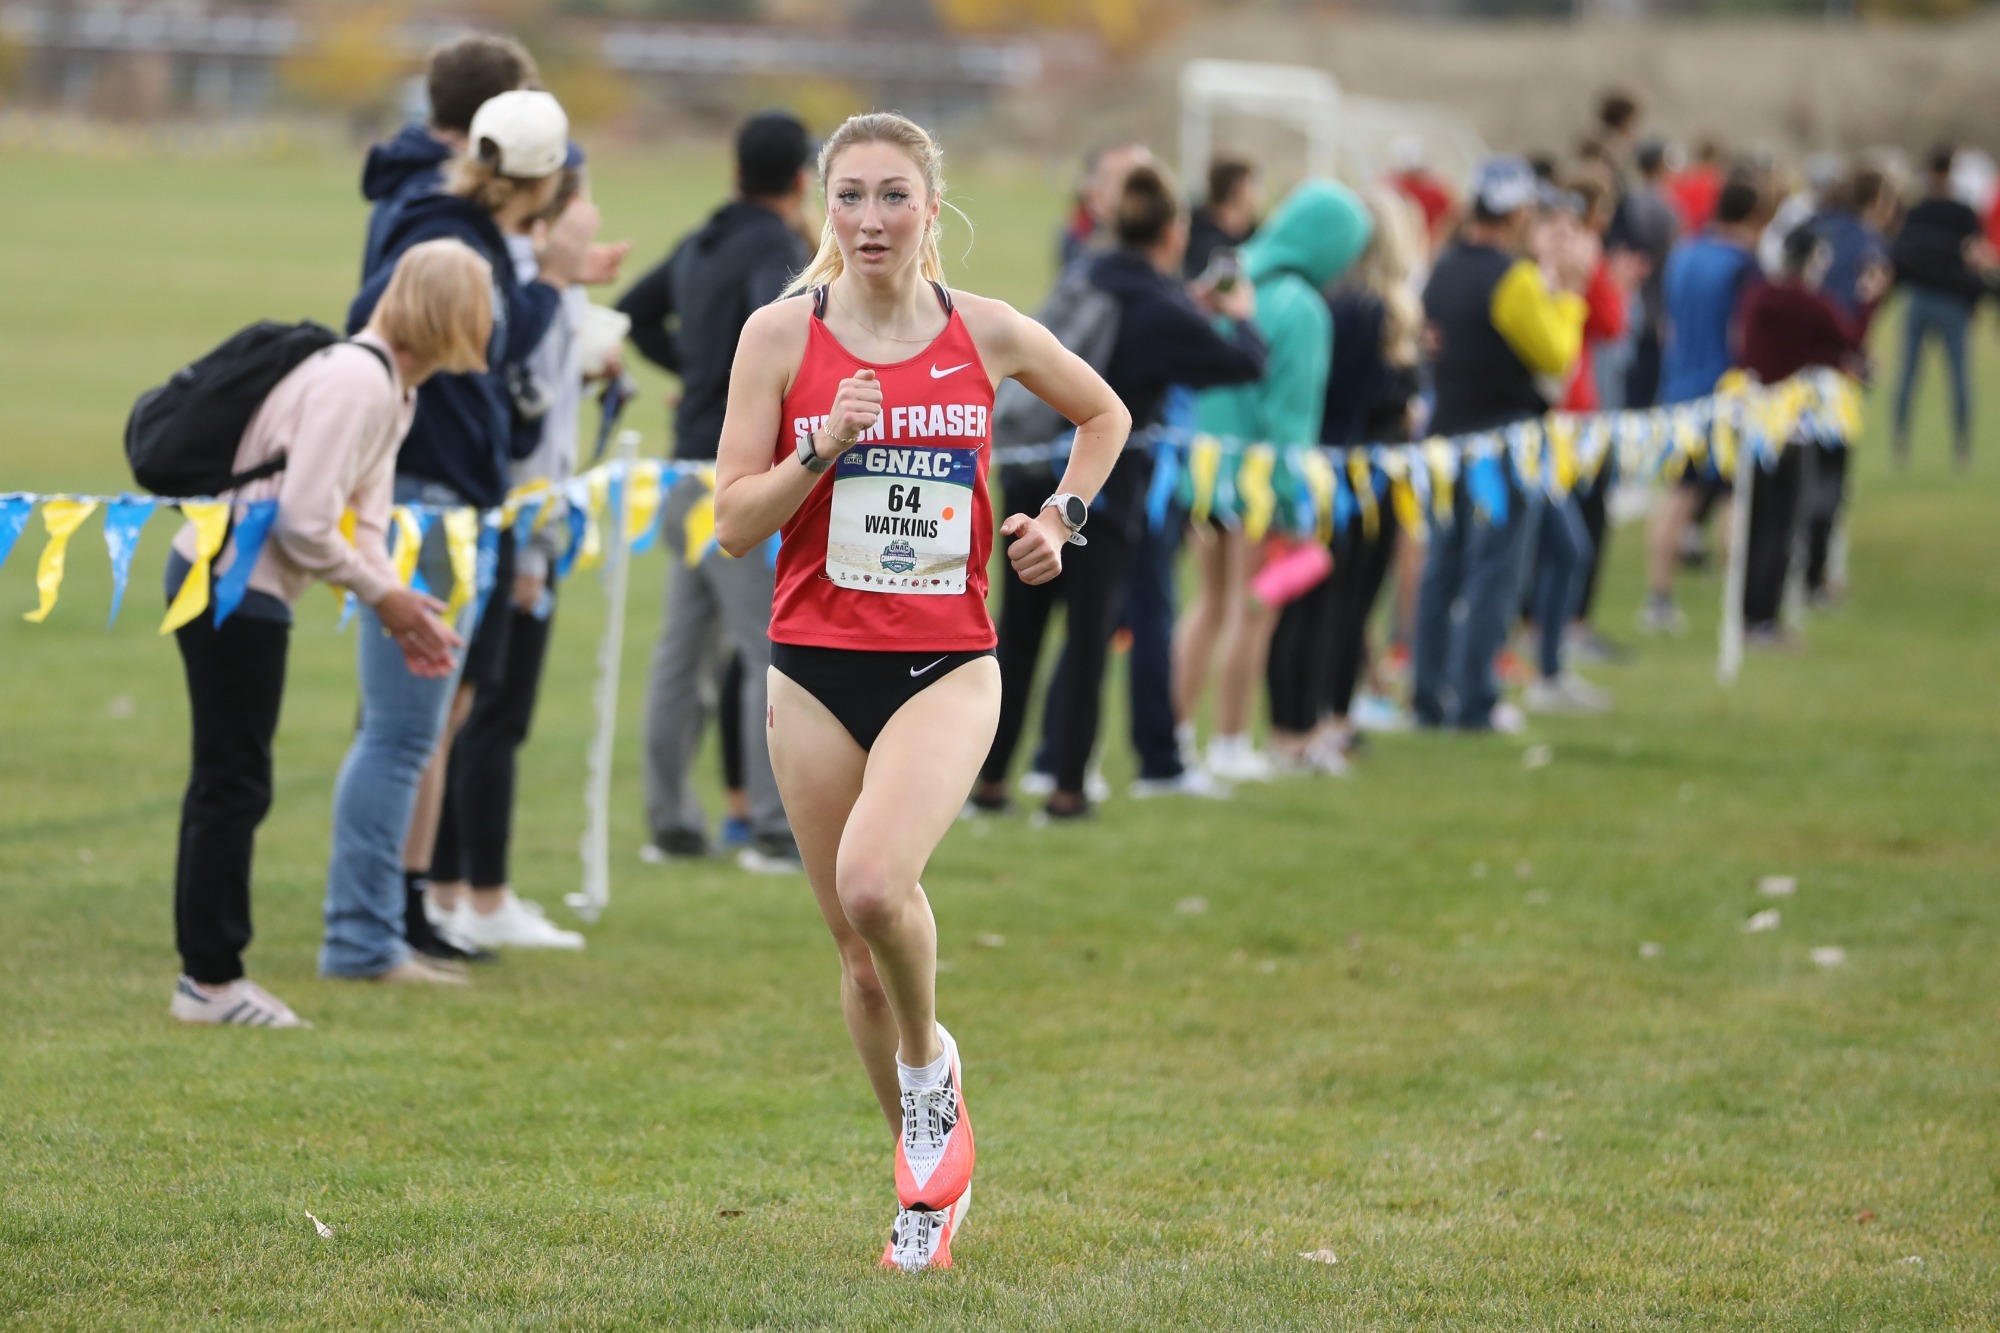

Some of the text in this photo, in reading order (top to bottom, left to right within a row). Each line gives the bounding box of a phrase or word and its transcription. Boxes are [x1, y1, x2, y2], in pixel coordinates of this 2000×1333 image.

[794, 404, 987, 443] SIN FRASER
[865, 448, 952, 478] GNAC
[888, 484, 921, 513] 64
[865, 515, 938, 538] WATKINS
[890, 544, 909, 552] GNAC
